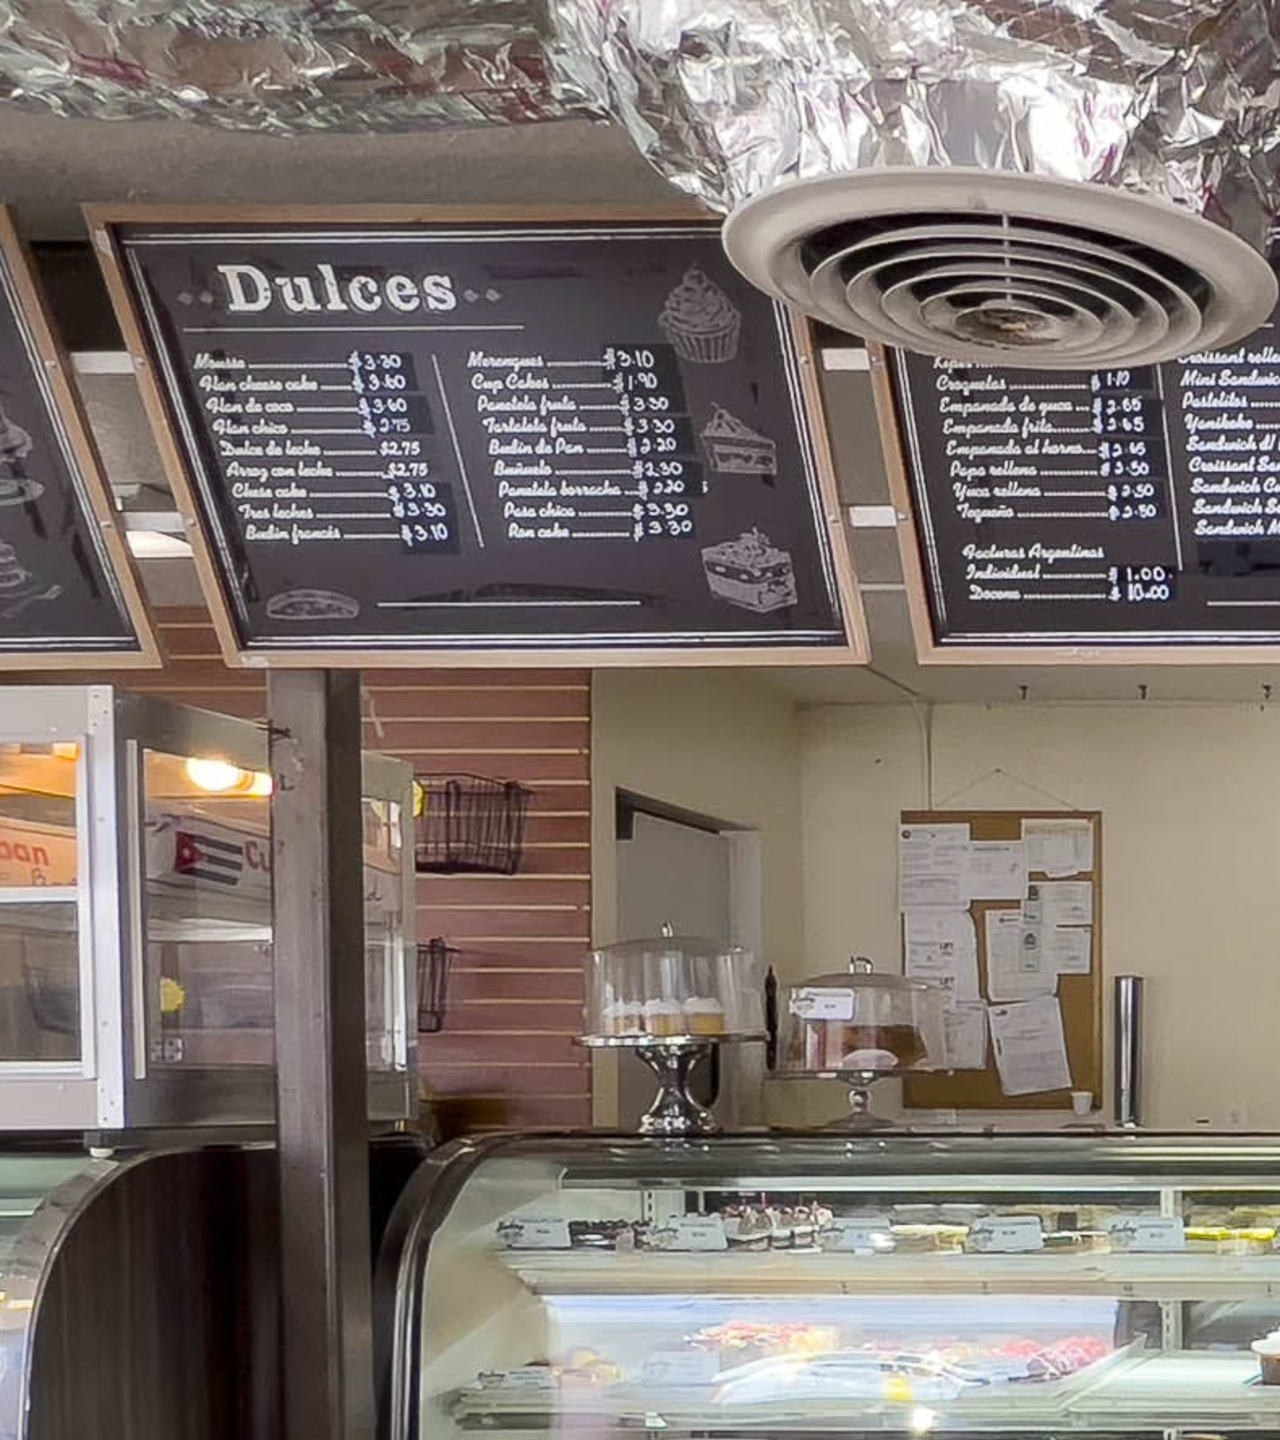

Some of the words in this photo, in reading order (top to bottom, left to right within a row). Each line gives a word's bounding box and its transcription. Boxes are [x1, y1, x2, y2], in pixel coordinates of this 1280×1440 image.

[219, 263, 458, 315] Dulces
[467, 351, 545, 372] Merengues
[199, 375, 237, 392] Flan
[285, 375, 318, 391] cake
[471, 373, 504, 394] Cup
[504, 372, 551, 390] Cakes
[935, 375, 1007, 396] Croquetas
[1180, 369, 1217, 388] Mini
[205, 397, 240, 413] Flan
[245, 397, 263, 413] de
[265, 401, 295, 413] coco
[540, 395, 578, 416] fruta
[939, 396, 1017, 418] Empanada
[1018, 395, 1037, 413] de
[1038, 400, 1073, 417] yuca
[1182, 391, 1249, 409] Pastelitos
[212, 419, 249, 435] Flan
[251, 420, 289, 435] chico
[550, 416, 588, 438] fruta
[942, 417, 1019, 439] Empanada
[219, 441, 264, 456] Dulce
[265, 441, 283, 456] de
[285, 441, 321, 456] leche
[534, 439, 553, 455] de
[555, 438, 585, 455] Pan
[945, 439, 1022, 461] Empanada
[1041, 439, 1082, 455] horno
[1185, 433, 1258, 452] Sandwich
[225, 461, 270, 482] Arroz
[271, 465, 296, 477] con
[297, 461, 334, 477] leche
[949, 460, 987, 481] Papa
[988, 460, 1038, 477] rellena
[1187, 456, 1256, 474] Croissant
[952, 481, 991, 502] Yuca
[992, 481, 1042, 498] rellena
[1189, 477, 1261, 495] Sandwich
[238, 504, 271, 519] Tres
[272, 503, 314, 519] leches
[1191, 498, 1263, 515] Sandwich
[537, 523, 570, 539] cake
[1194, 519, 1266, 537] Sandwich
[961, 543, 1026, 560] Facturas
[1027, 542, 1105, 564] Argentinas
[965, 563, 1042, 581] Individual
[968, 584, 1022, 601] Docena
